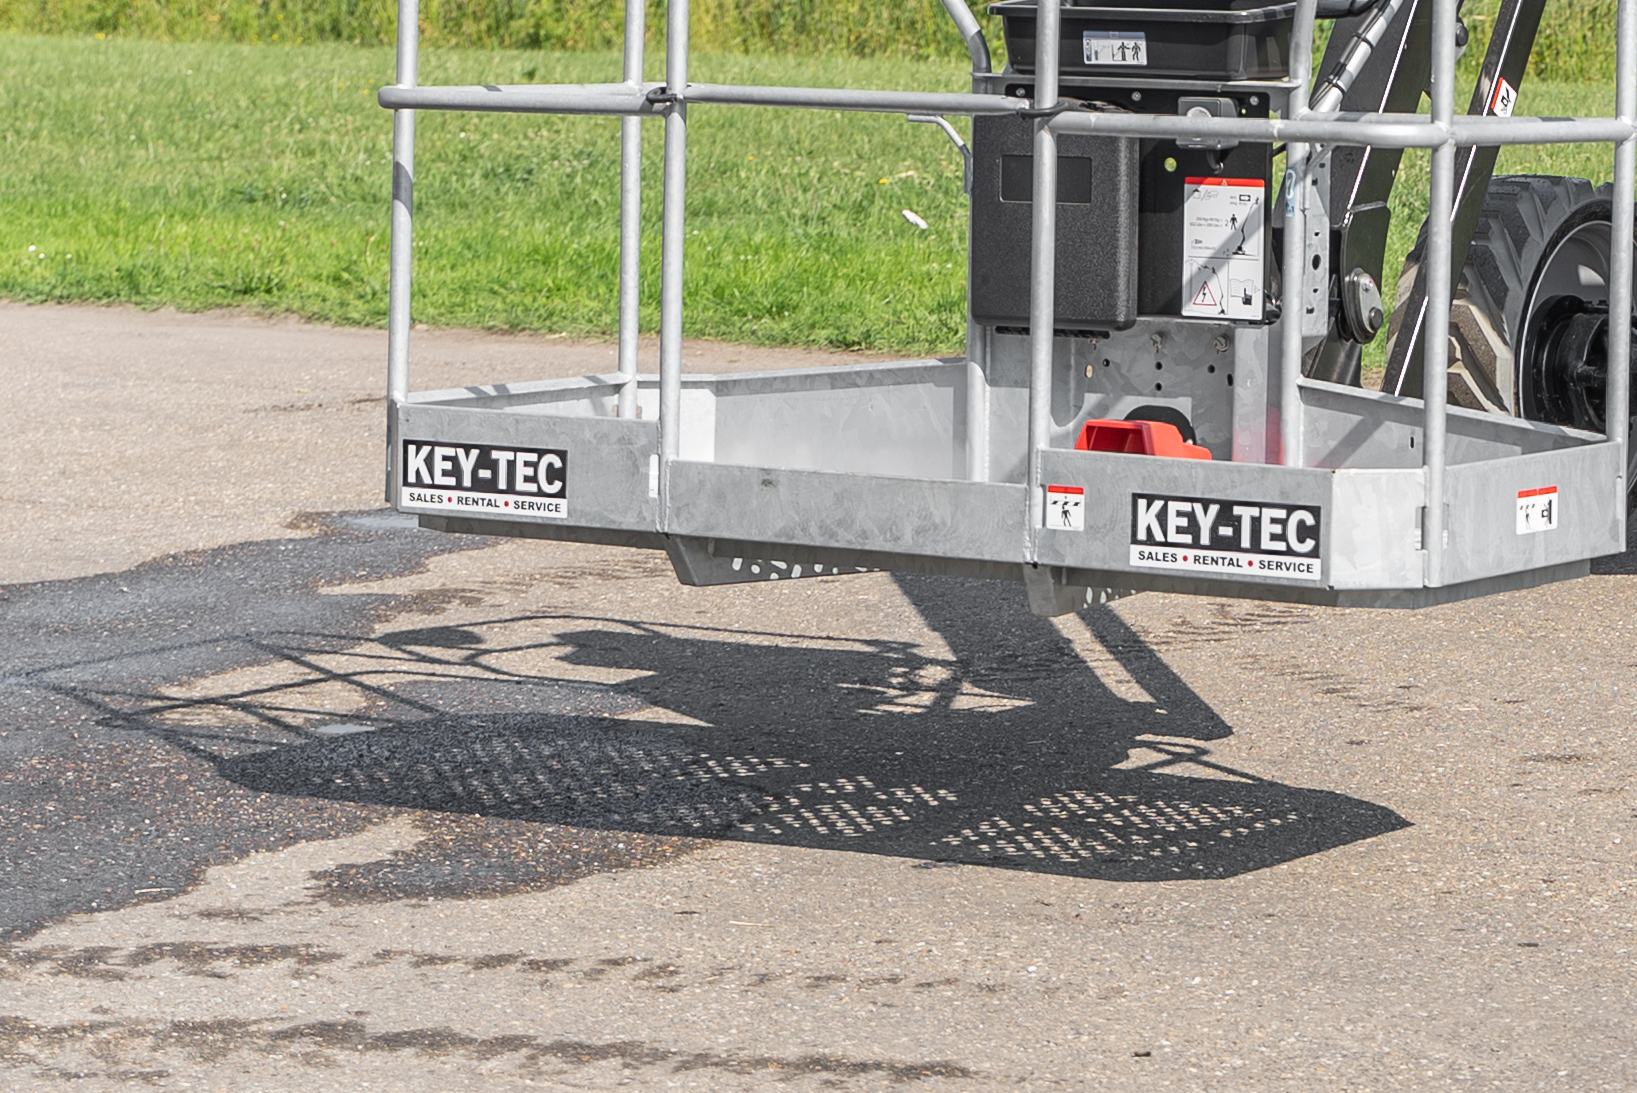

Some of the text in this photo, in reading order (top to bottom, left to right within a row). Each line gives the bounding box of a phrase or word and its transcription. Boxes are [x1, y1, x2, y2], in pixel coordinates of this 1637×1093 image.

[407, 444, 563, 494] KEY-TEC
[408, 492, 562, 513] SALES RENTAL SERVICE
[1136, 498, 1316, 554] KEY-TEC
[1138, 550, 1314, 574] SALES RENTAL SERVICE
